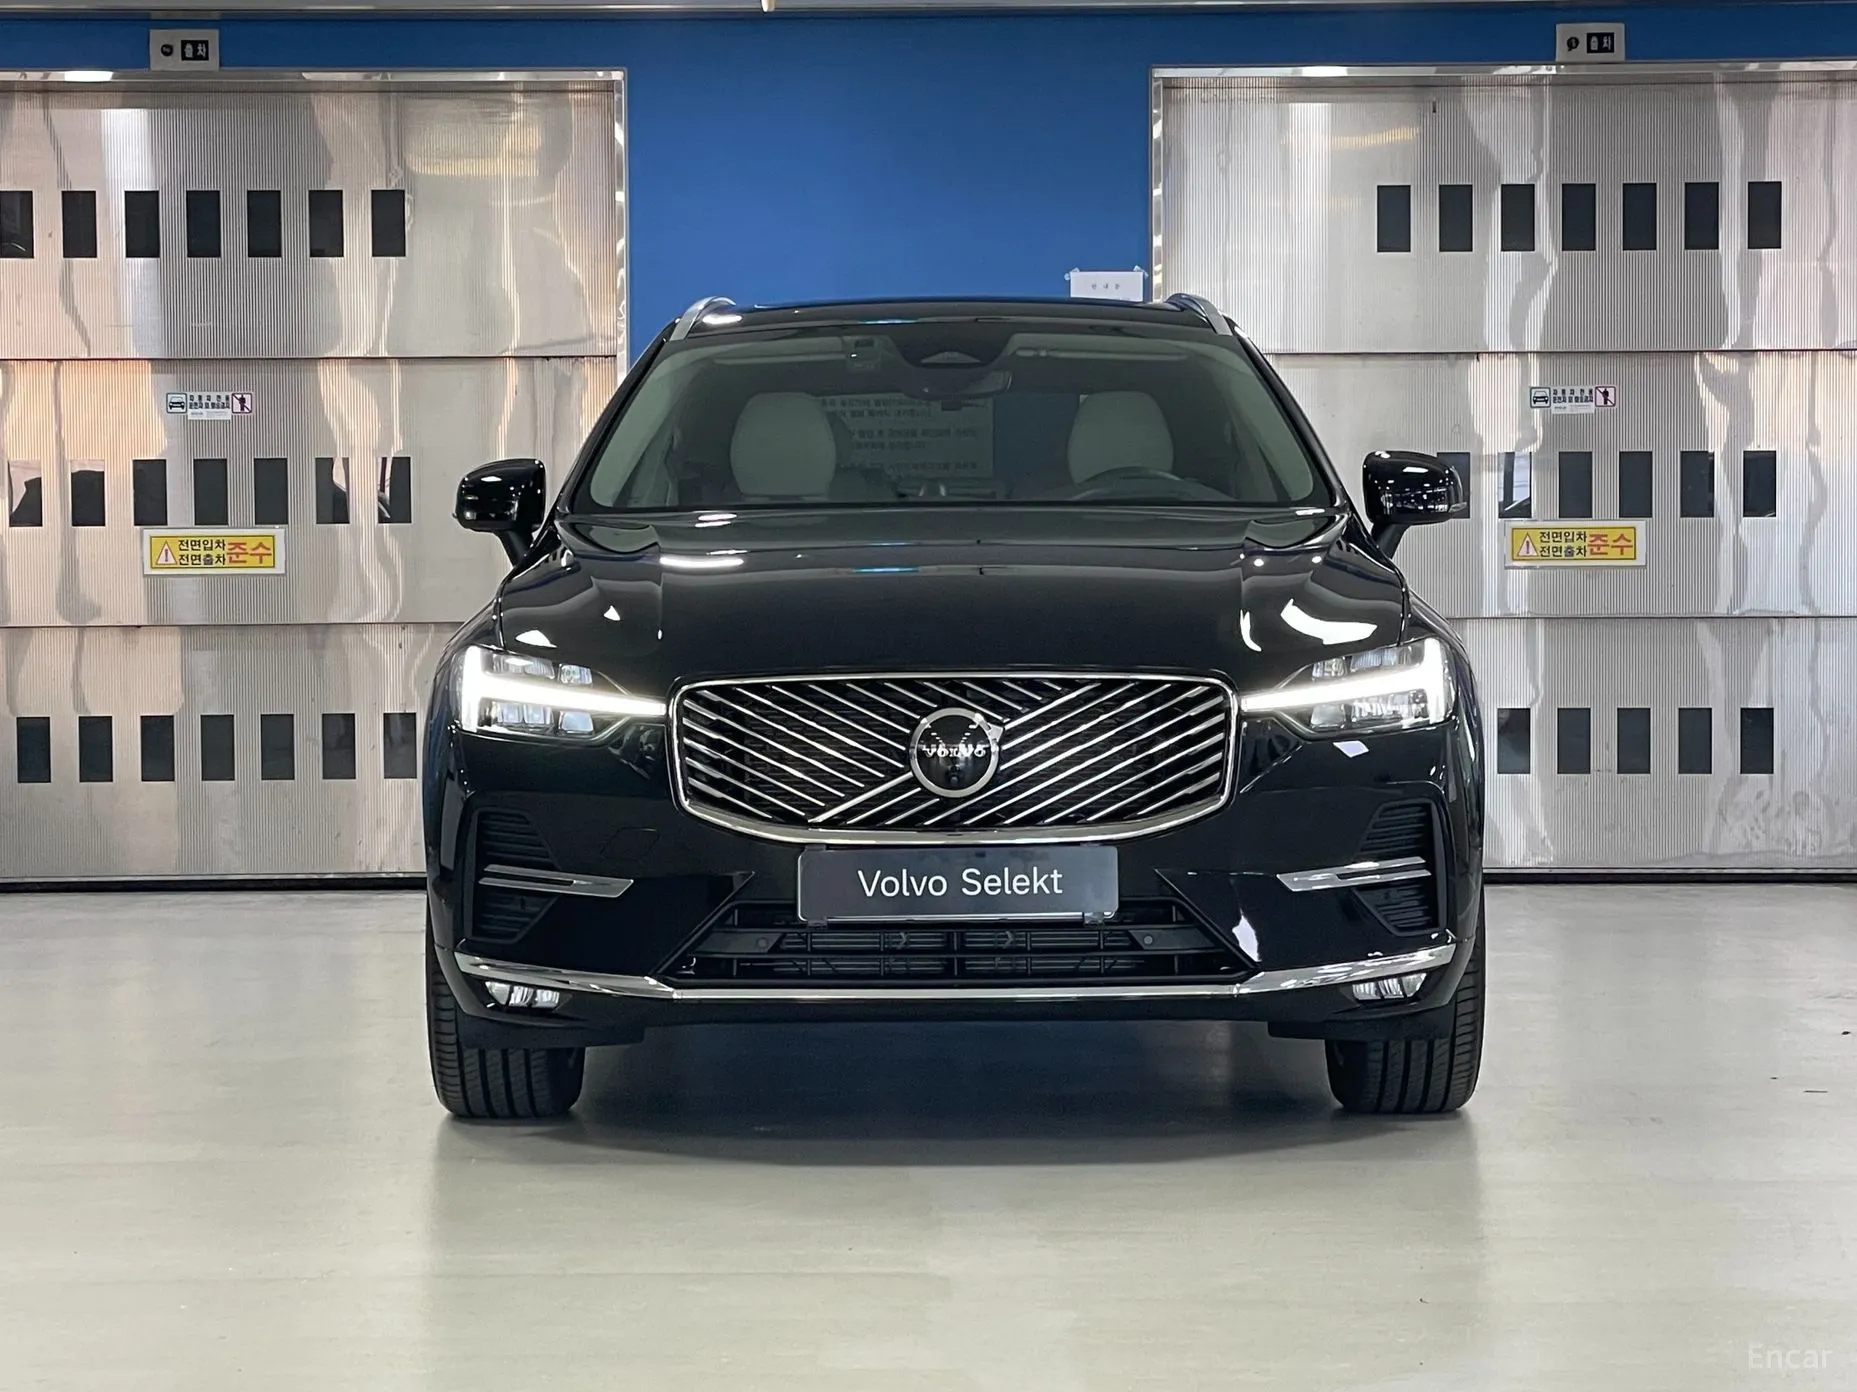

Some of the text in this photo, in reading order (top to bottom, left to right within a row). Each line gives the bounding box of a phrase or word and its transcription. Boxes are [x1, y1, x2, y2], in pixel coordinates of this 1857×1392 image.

[1539, 531, 1587, 543] 전면입차
[178, 539, 226, 551] 전면입차
[1539, 545, 1587, 558] 전면출차
[1587, 533, 1634, 556] 준수
[178, 553, 226, 566] 전면출차
[226, 541, 273, 564] 준수
[921, 743, 988, 758] VOLVO
[857, 866, 1063, 897] Volvo Selekt
